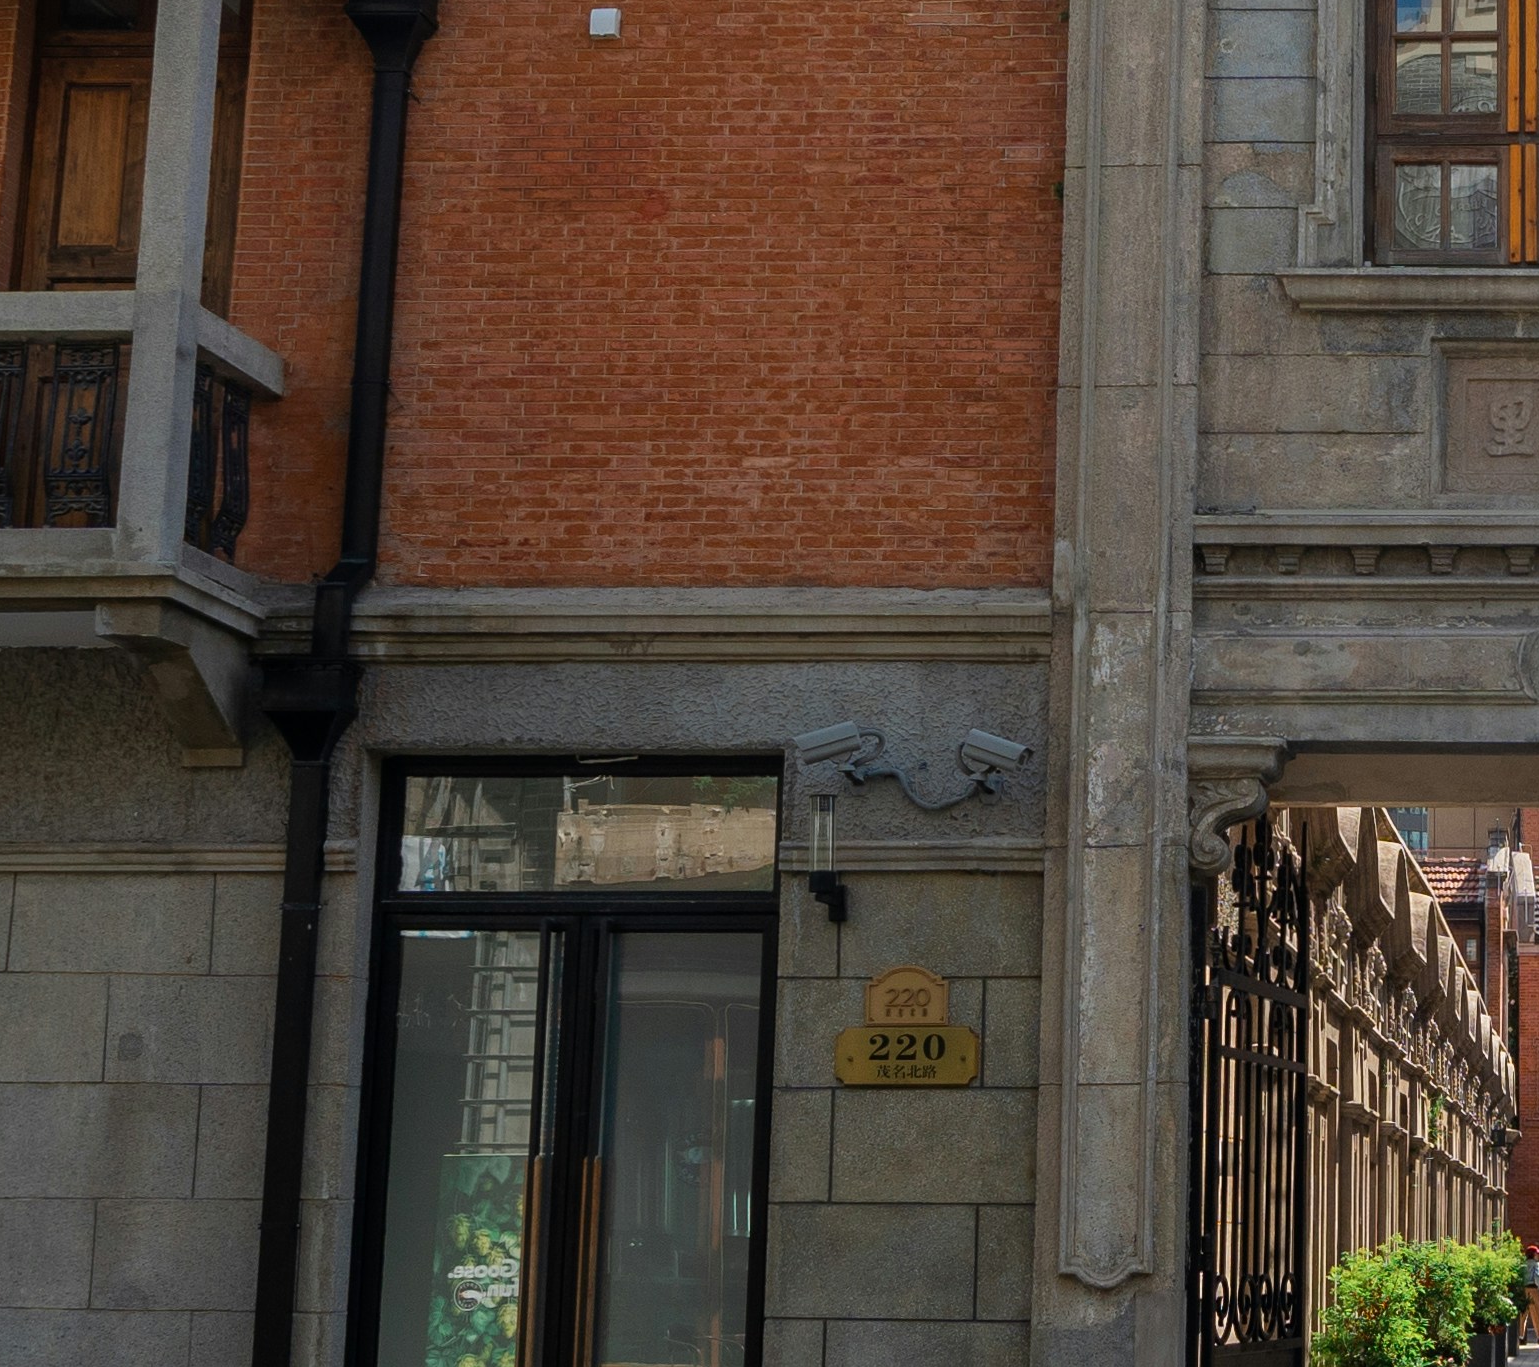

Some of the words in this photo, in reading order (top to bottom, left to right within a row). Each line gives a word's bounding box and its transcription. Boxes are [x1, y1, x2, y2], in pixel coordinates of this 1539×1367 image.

[885, 988, 931, 1008] 220
[869, 1033, 946, 1061] 220
[876, 1064, 937, 1079] 茂名北路
